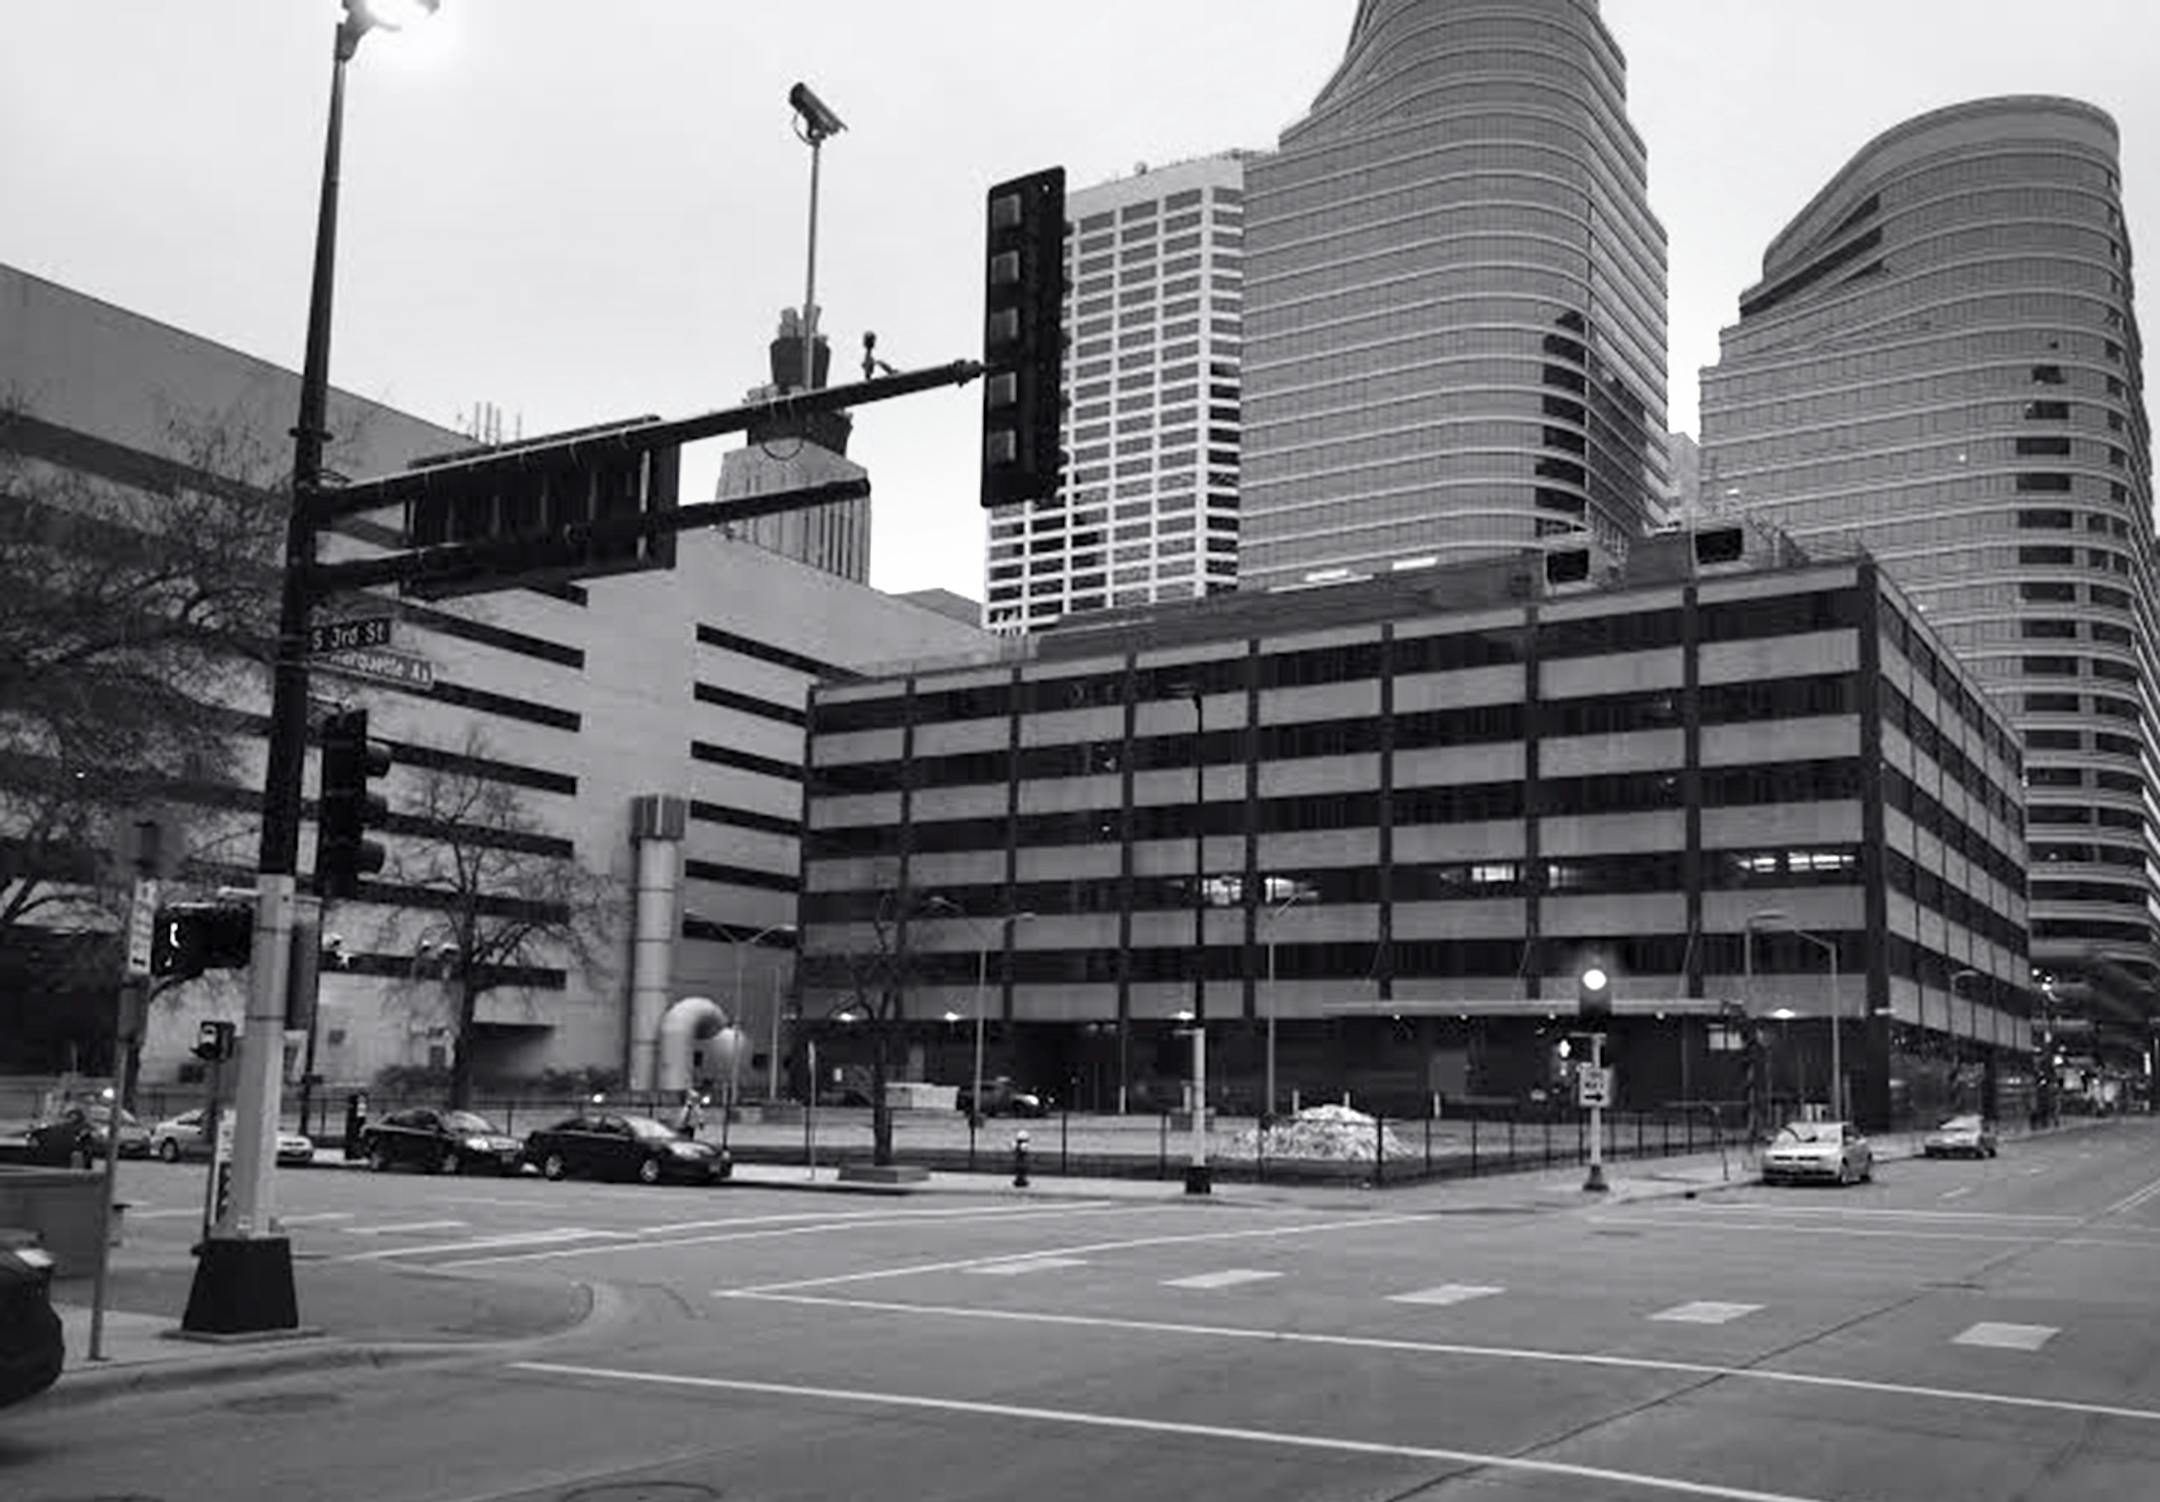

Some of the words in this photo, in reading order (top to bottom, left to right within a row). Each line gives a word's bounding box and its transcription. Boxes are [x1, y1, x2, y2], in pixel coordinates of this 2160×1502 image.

[312, 629, 323, 650] S
[330, 625, 359, 648] 3rd
[365, 621, 385, 643] St
